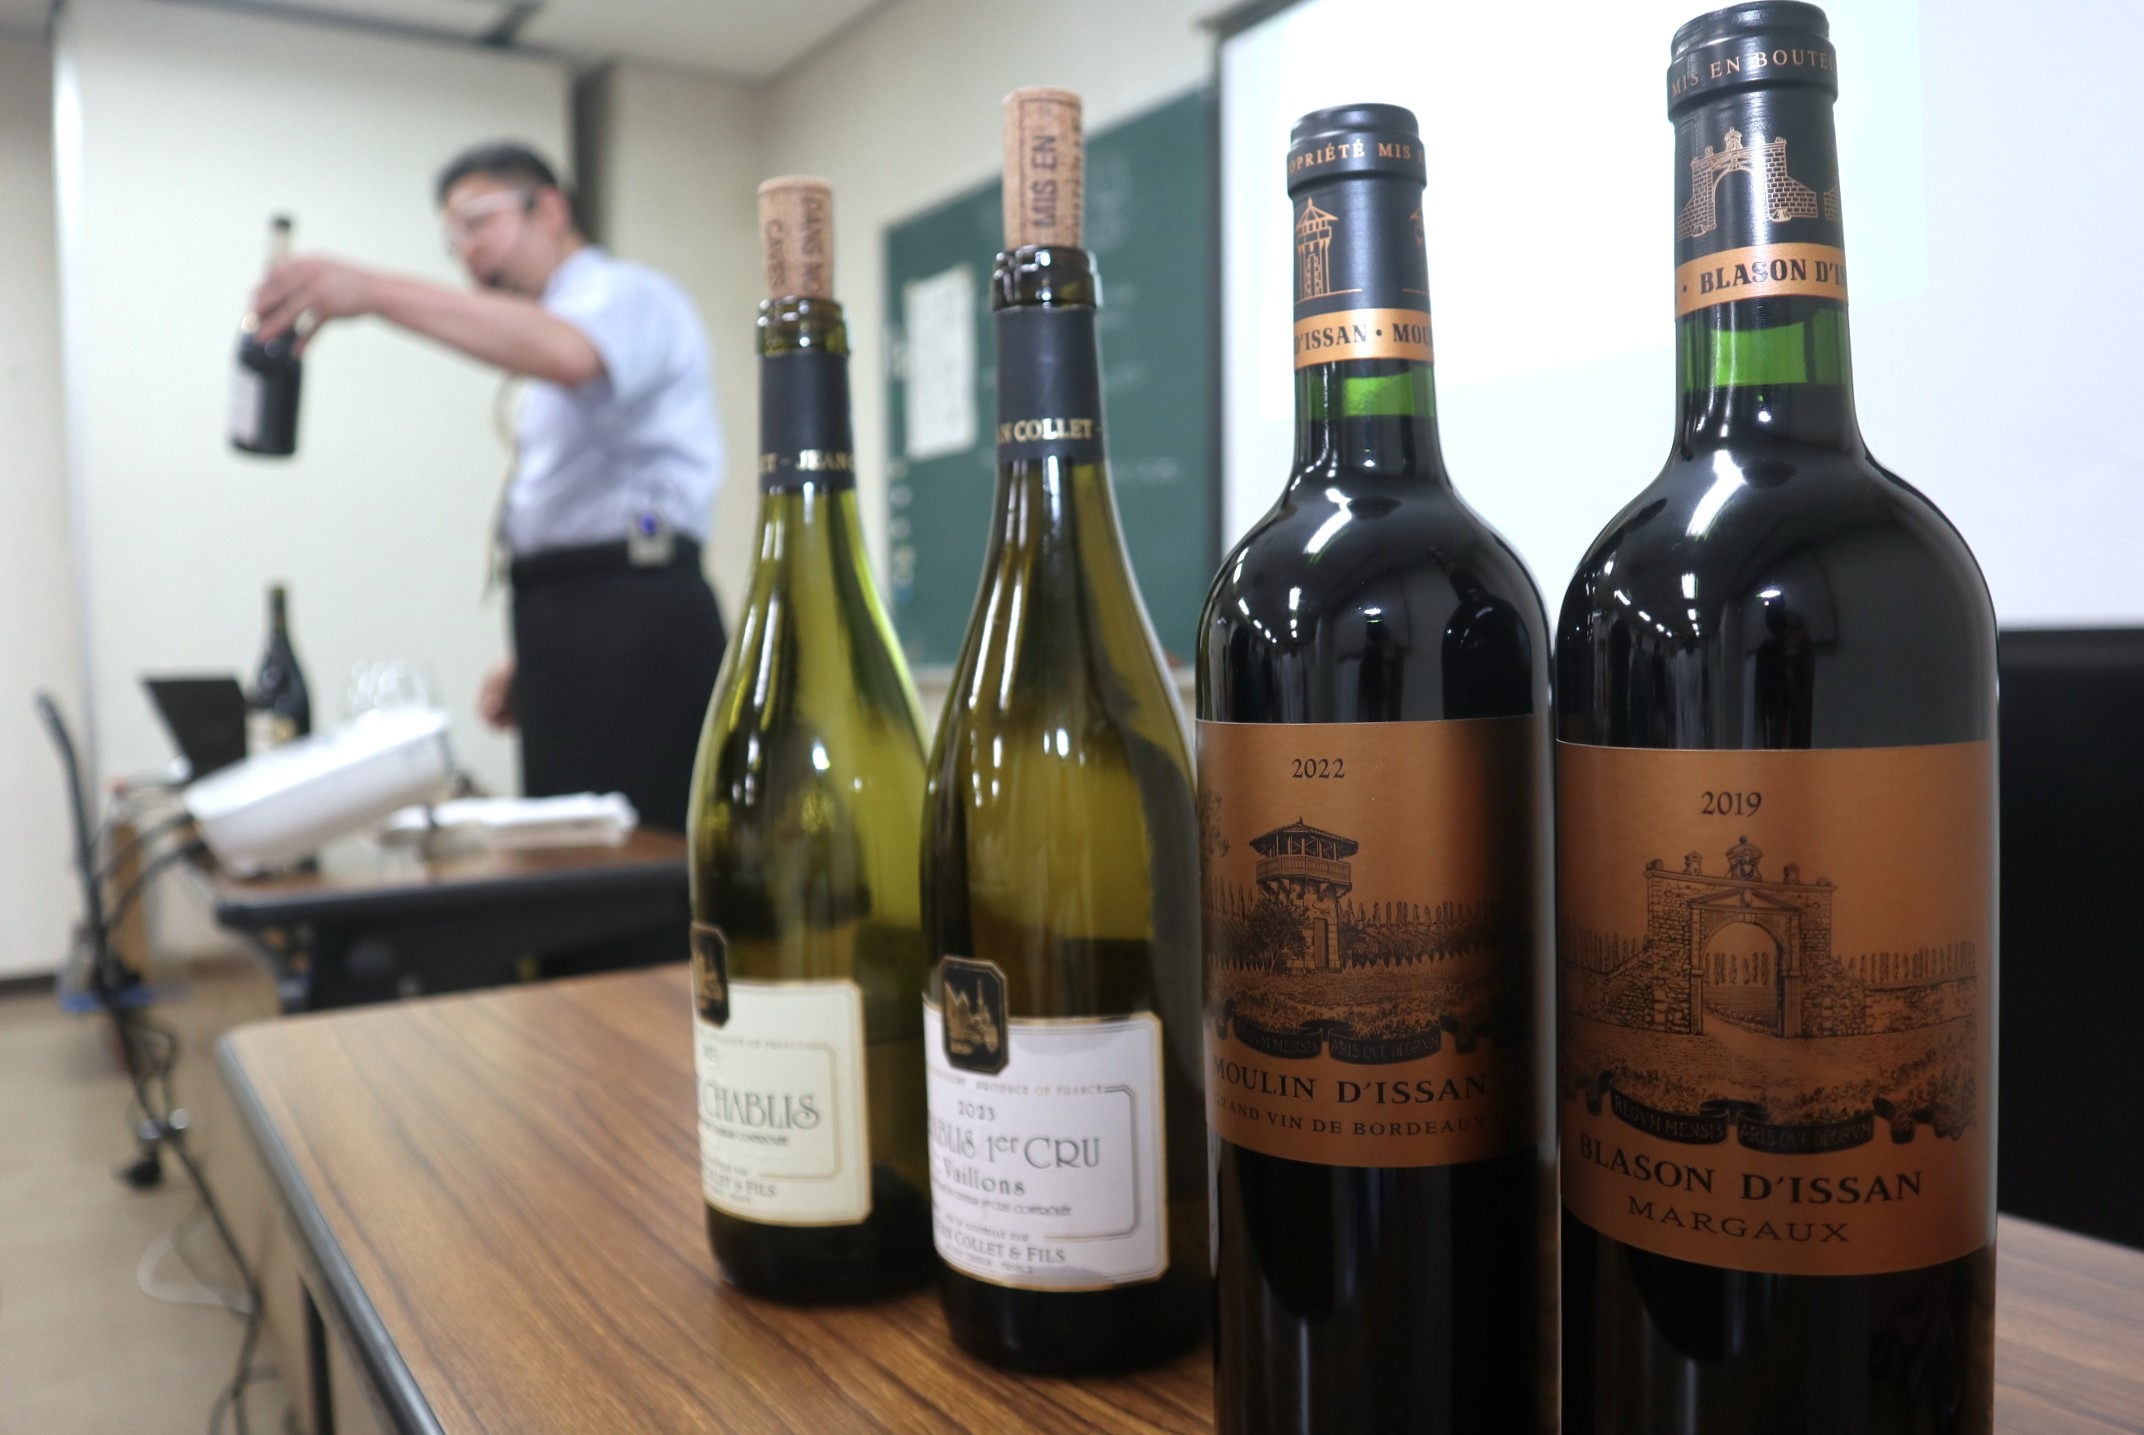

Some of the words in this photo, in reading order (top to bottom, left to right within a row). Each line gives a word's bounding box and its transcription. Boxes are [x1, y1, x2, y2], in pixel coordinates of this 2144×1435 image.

[1672, 72, 1699, 98] MIS
[1710, 56, 1741, 80] EN
[1032, 135, 1057, 170] EN
[1378, 143, 1411, 160] MIS
[1031, 179, 1057, 228] MIS
[1700, 258, 1807, 295] BLASON
[1014, 417, 1092, 443] COLLET
[1292, 757, 1346, 779] 2022
[1701, 791, 1763, 818] 2019
[1034, 1085, 1050, 1097] OF
[1212, 1055, 1316, 1100] MOULIN
[1337, 1075, 1487, 1105] D'ISSAN
[702, 1080, 821, 1130] CHABLIS
[957, 1099, 997, 1122] 2023
[1213, 1095, 1260, 1121] GRAND
[1267, 1112, 1304, 1130] VIN
[1312, 1119, 1343, 1135] DE
[1353, 1115, 1487, 1137] BORDEAUX
[1664, 1118, 1725, 1140] MENSIS
[1024, 1136, 1101, 1169] CRU
[1579, 1131, 1715, 1195] BLASON
[1740, 1171, 1923, 1205] D'ISSAN
[745, 1180, 777, 1198] FILS
[943, 1157, 1026, 1197] Vaillons
[1628, 1195, 1850, 1243] MARGAUX
[955, 1230, 1005, 1259] COLLET
[1008, 1245, 1022, 1261] &
[1026, 1245, 1067, 1264] FILS
